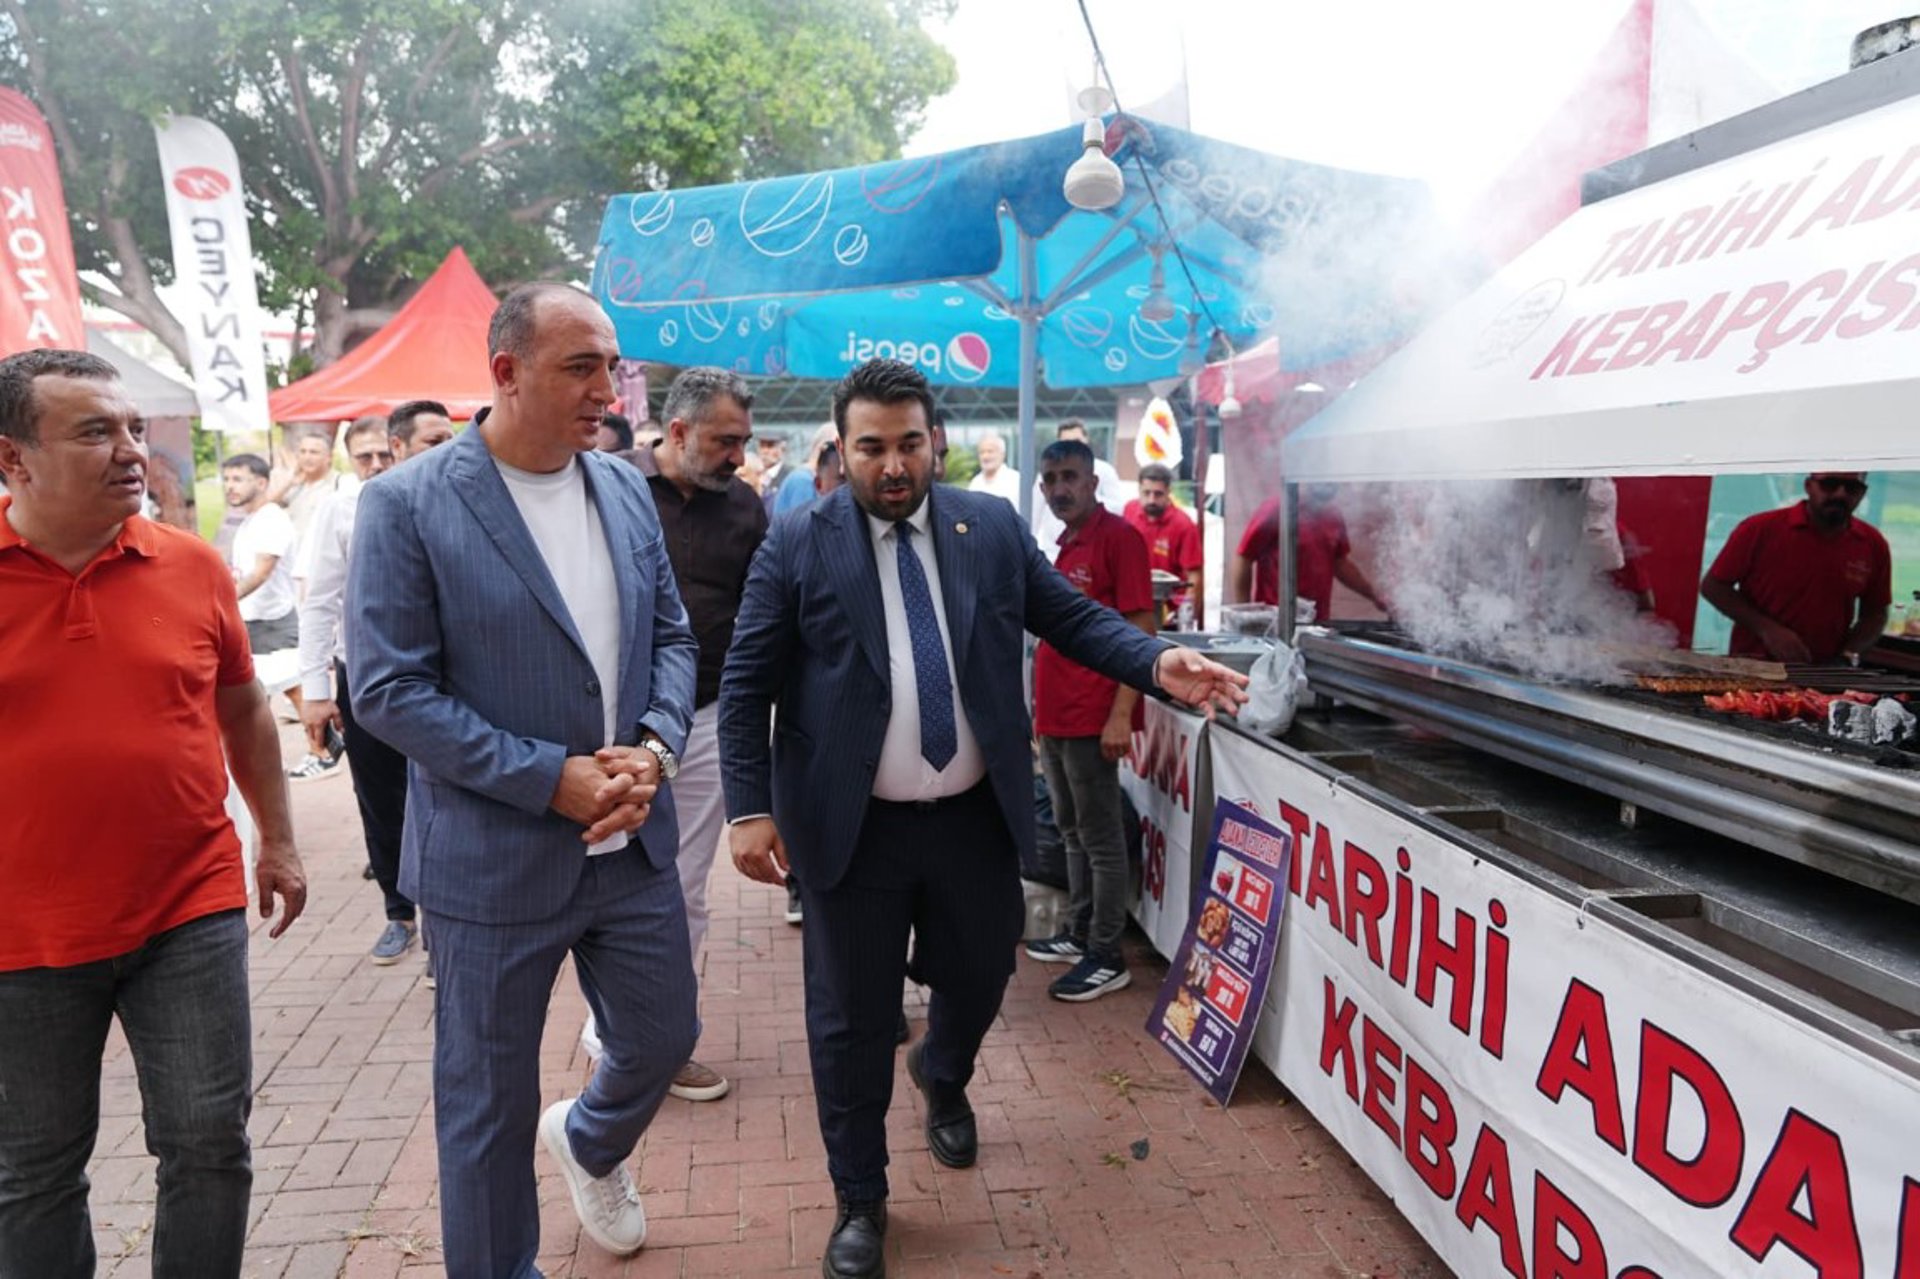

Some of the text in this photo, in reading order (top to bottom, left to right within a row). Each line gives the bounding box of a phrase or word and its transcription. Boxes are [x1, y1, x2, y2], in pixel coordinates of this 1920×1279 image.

[1529, 252, 1920, 381] KEBAPÇIS
[1578, 142, 1920, 288] TARİHİ AD
[1278, 798, 1920, 1279] TARİHİ ADA
[1319, 974, 1664, 1279] KEBAP
